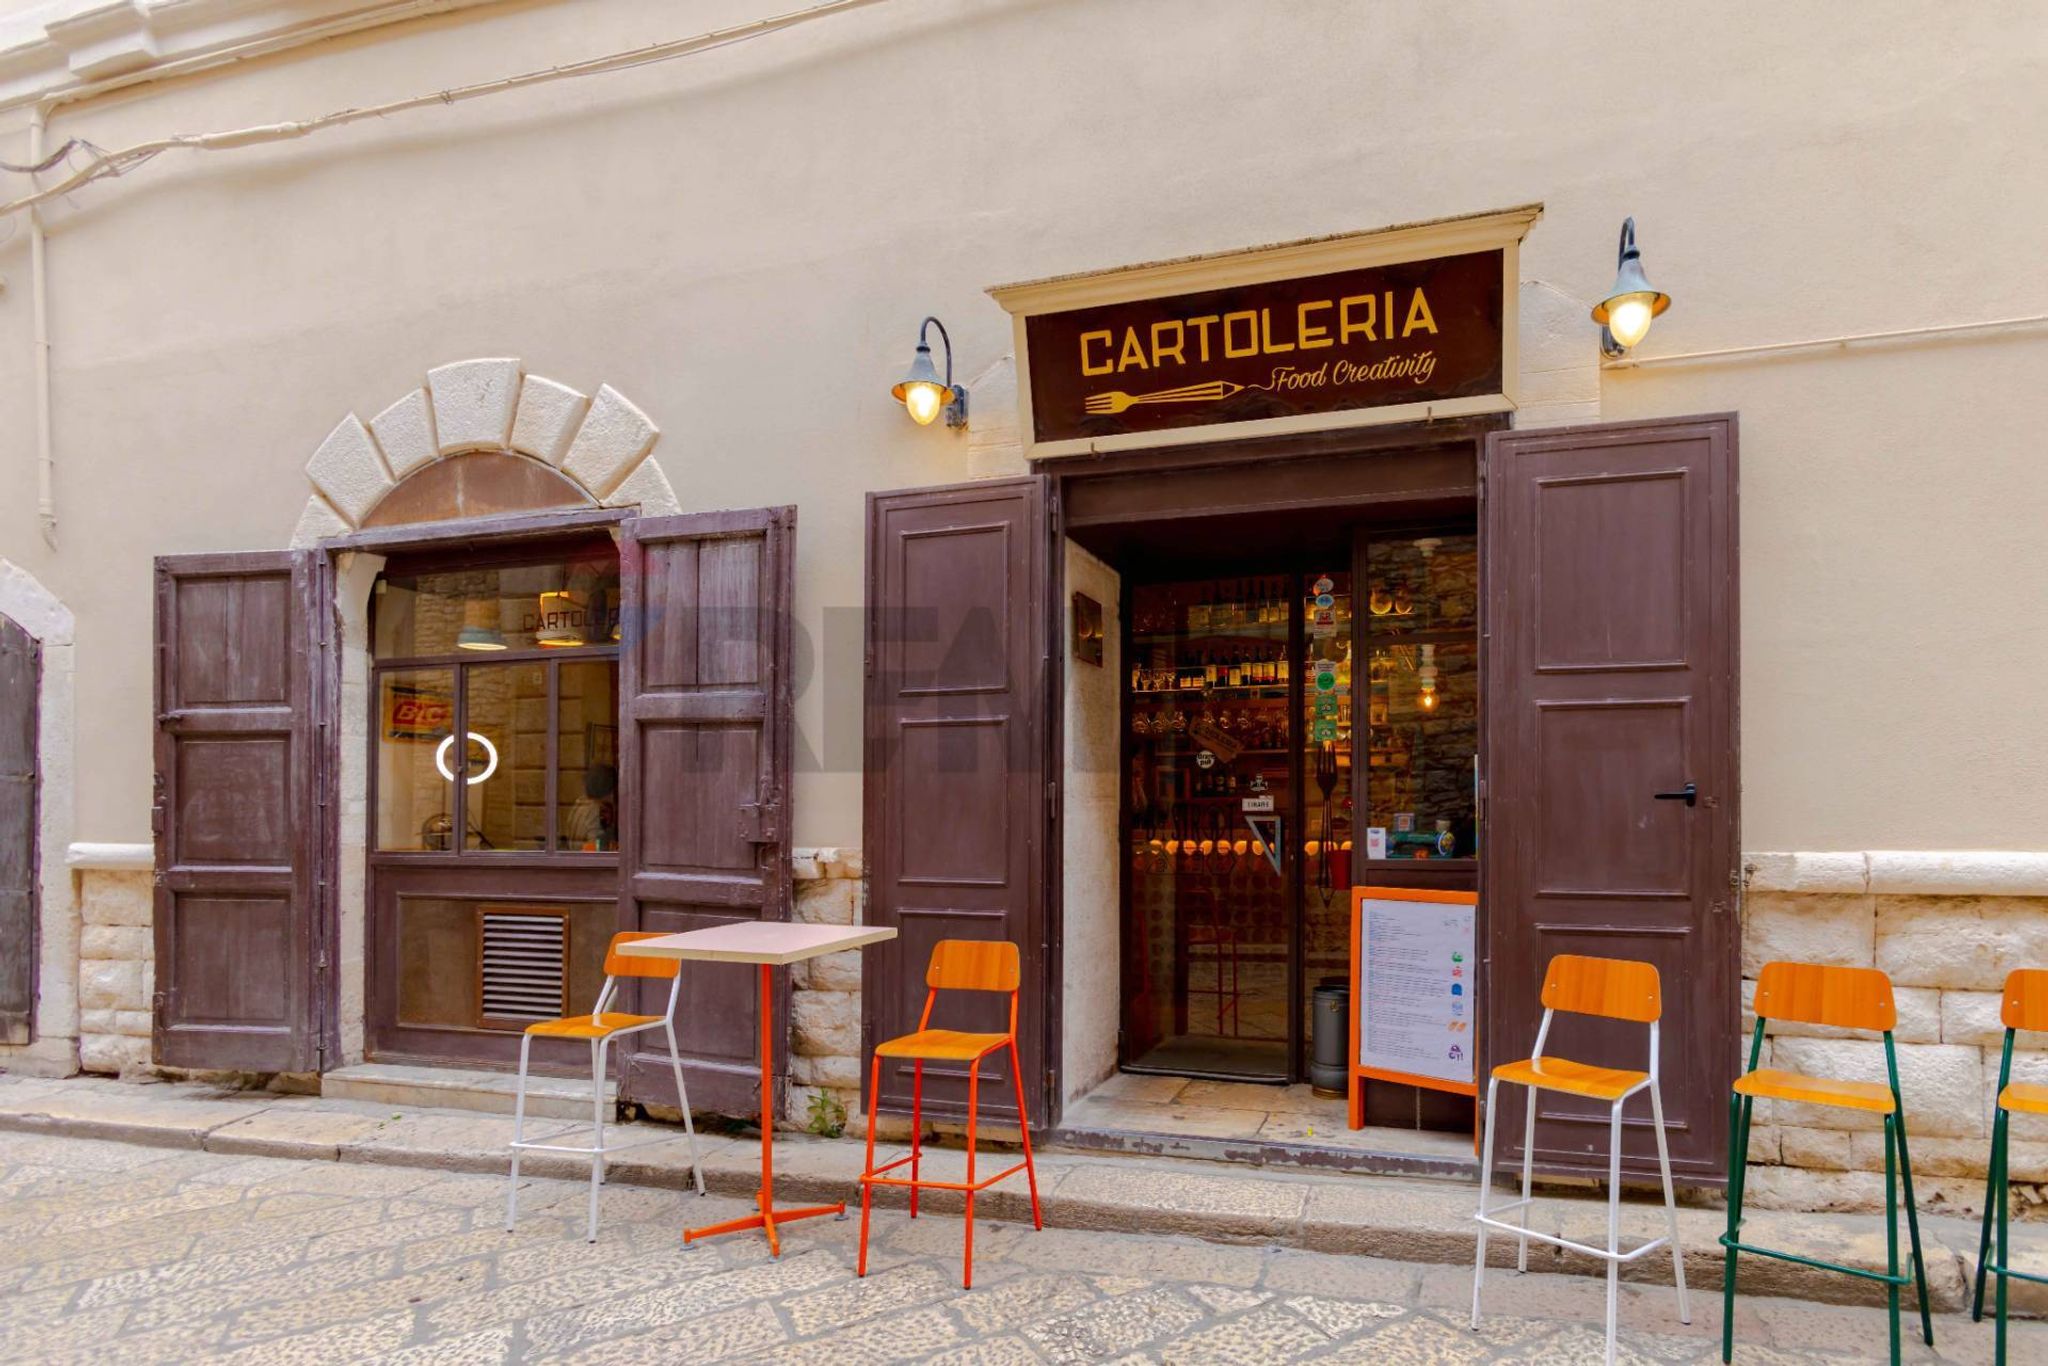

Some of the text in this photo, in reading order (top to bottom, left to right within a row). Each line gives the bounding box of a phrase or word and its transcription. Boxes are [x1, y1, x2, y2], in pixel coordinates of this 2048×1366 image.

[1080, 287, 1439, 376] CARTOLERIA
[1275, 349, 1438, 393] Food Creativity
